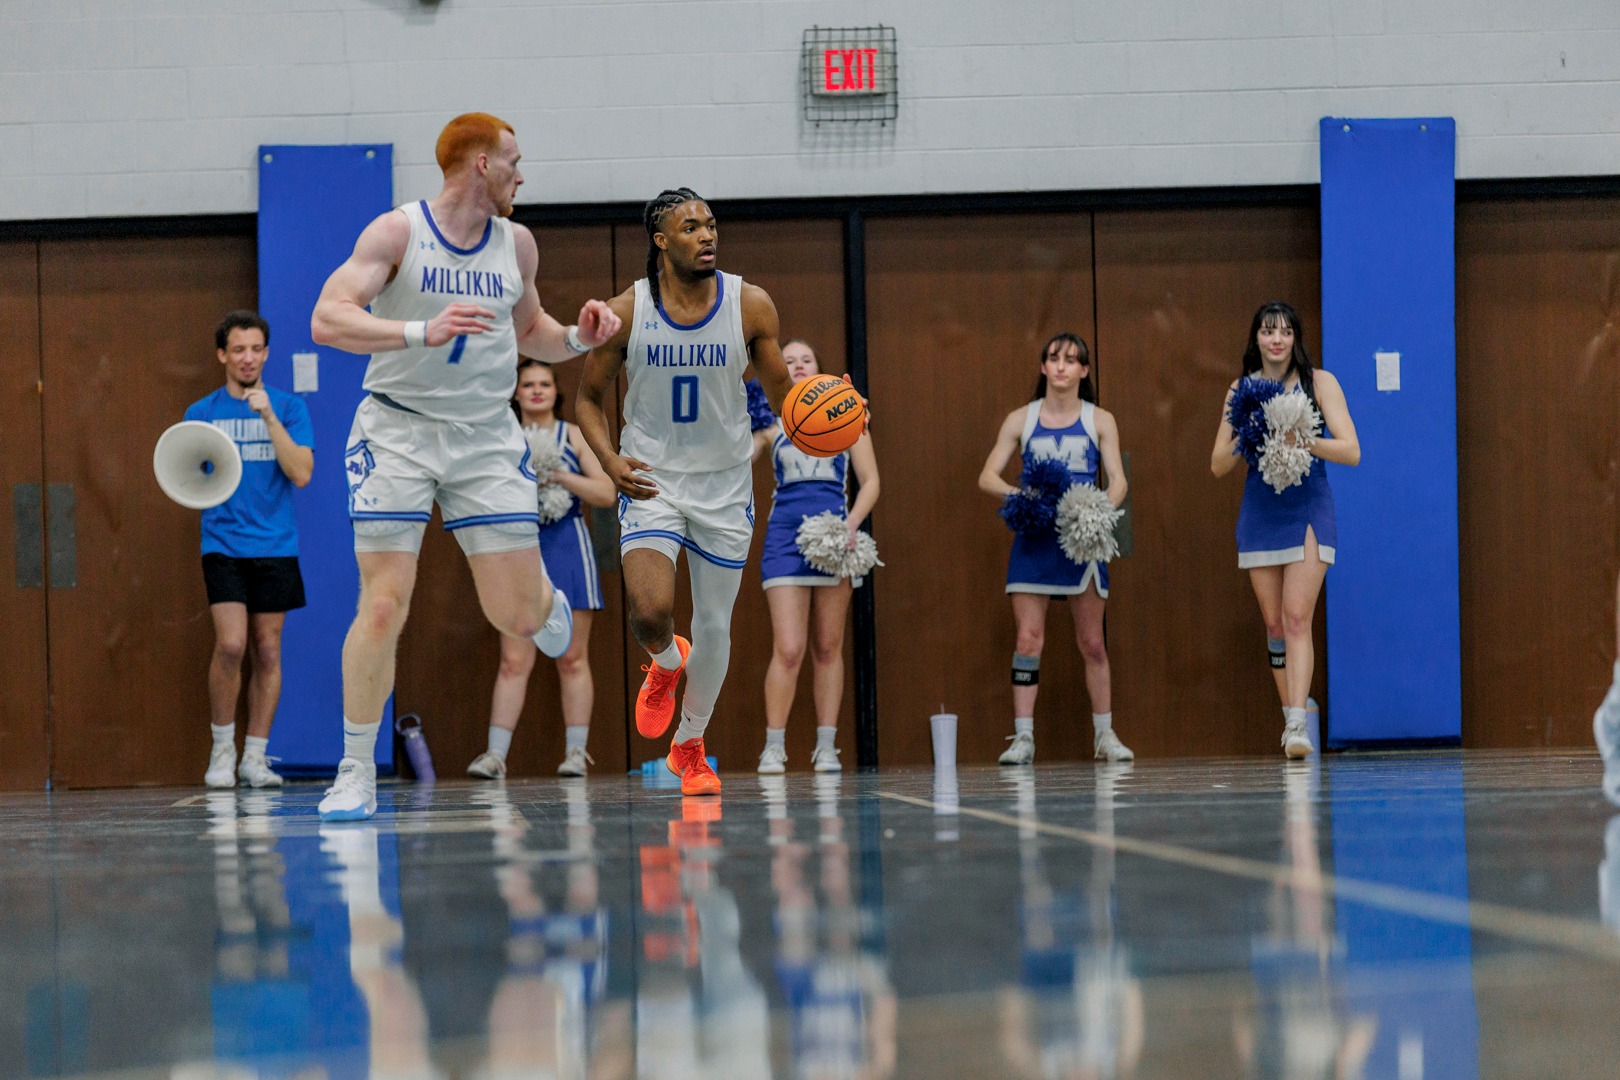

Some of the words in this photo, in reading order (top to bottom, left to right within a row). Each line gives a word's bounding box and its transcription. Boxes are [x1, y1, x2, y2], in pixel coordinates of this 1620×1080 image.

[824, 48, 878, 90] EXIT
[420, 266, 503, 298] MILLIKIN
[647, 344, 726, 367] MILLIKIN
[672, 375, 699, 423] 0
[800, 379, 848, 406] Wilson
[825, 395, 858, 421] NCAA
[1029, 434, 1090, 473] M
